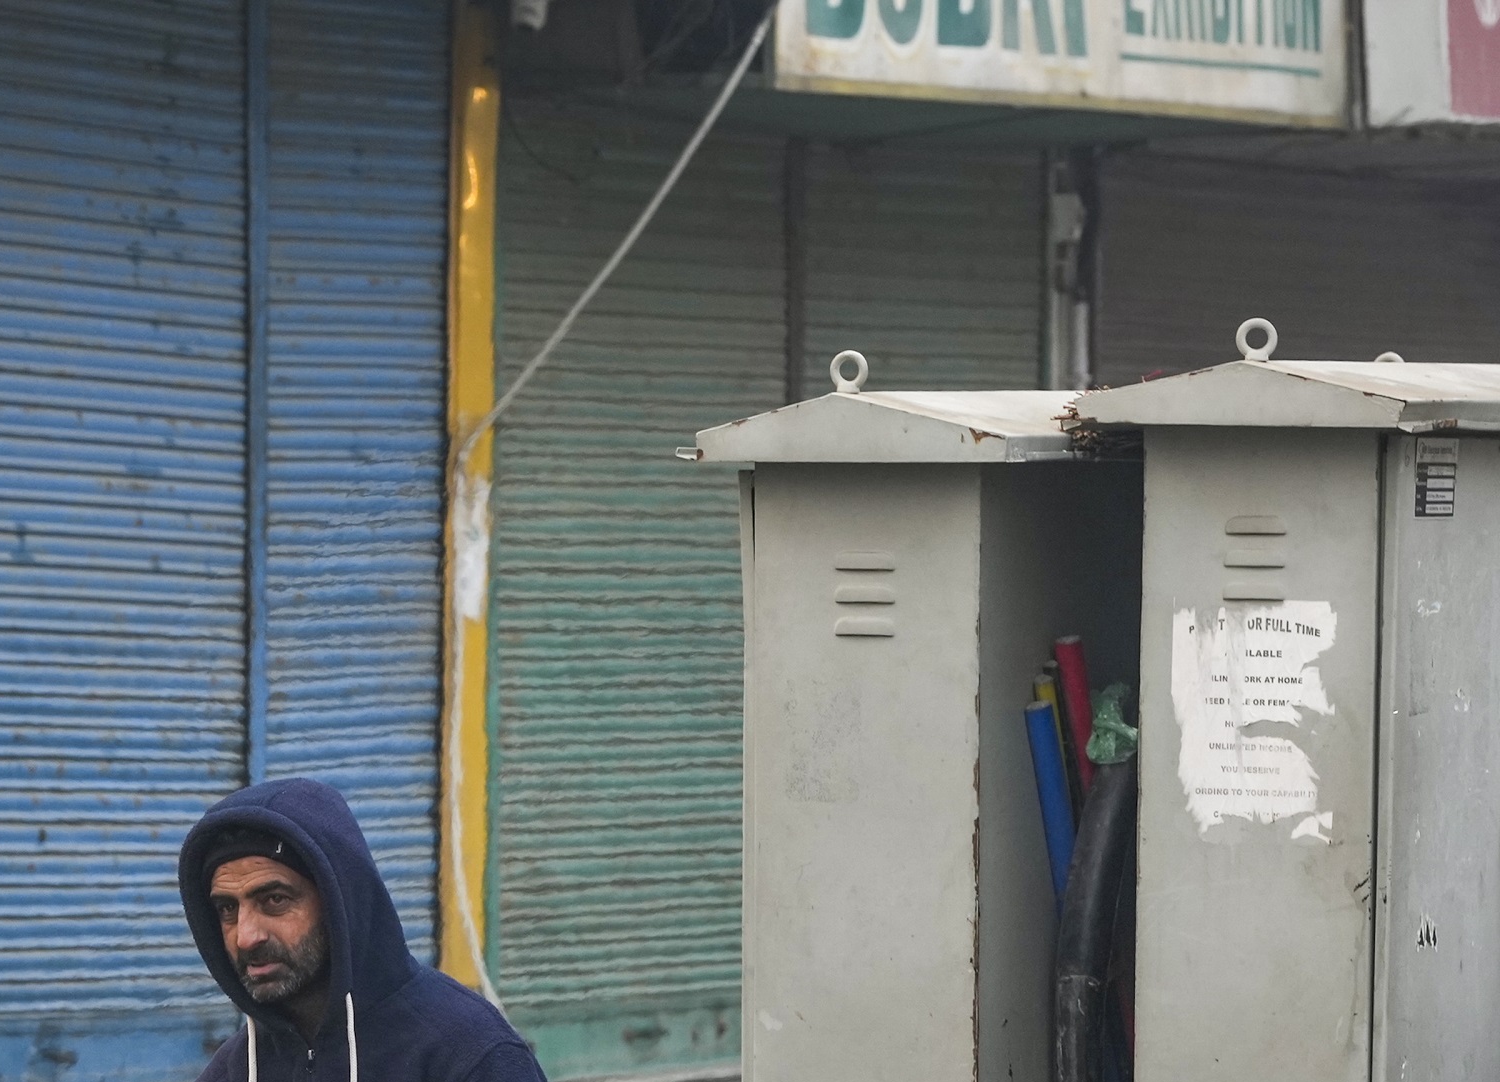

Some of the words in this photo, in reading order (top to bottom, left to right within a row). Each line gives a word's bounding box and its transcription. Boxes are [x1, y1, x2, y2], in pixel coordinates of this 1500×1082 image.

[1265, 617, 1292, 634] FULL
[1295, 622, 1321, 638] TIME
[1278, 677, 1303, 685] HOME
[1253, 698, 1265, 707] OR
[1220, 764, 1238, 774] YOU
[1231, 787, 1243, 796] TO
[1245, 788, 1269, 797] YOUR
